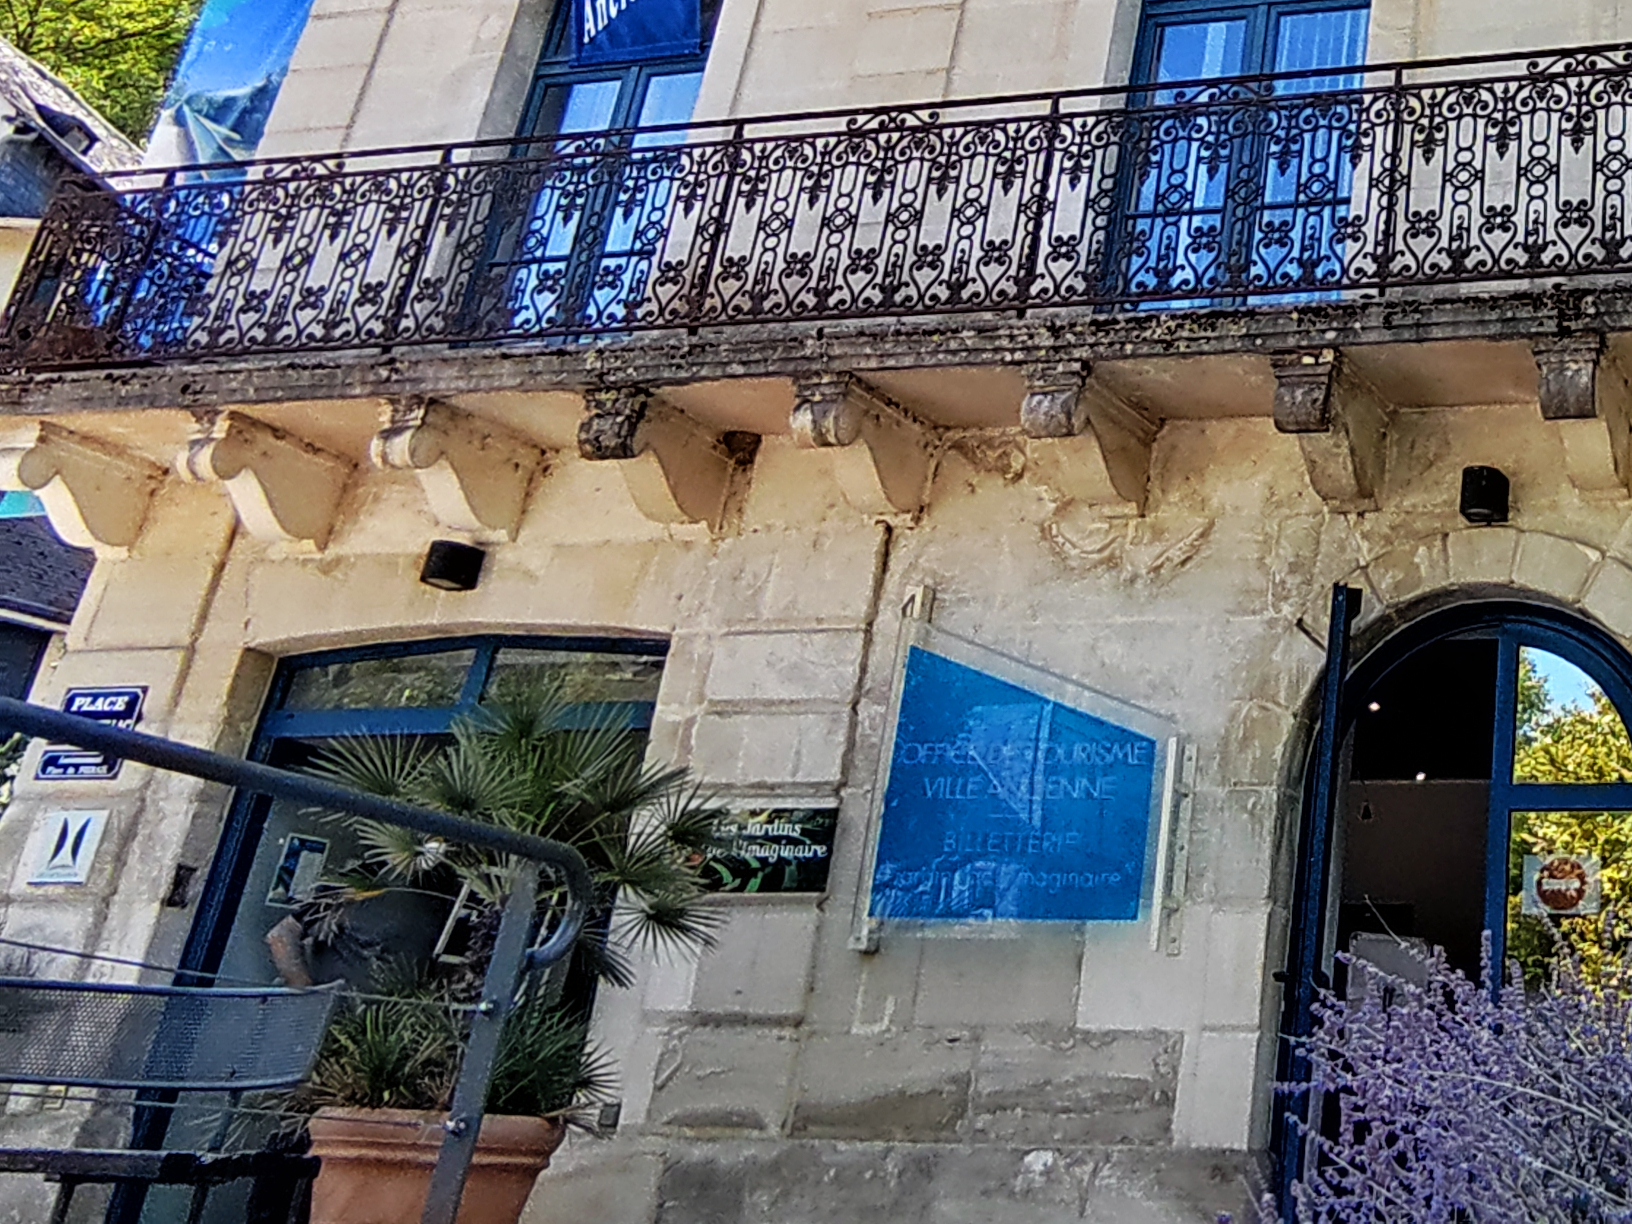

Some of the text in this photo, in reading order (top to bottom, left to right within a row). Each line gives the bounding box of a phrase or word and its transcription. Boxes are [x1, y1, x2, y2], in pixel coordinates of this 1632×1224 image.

[70, 696, 130, 712] PLACE
[1030, 741, 1149, 766] OURISME
[924, 775, 984, 800] VILLE
[741, 819, 801, 836] Jardins
